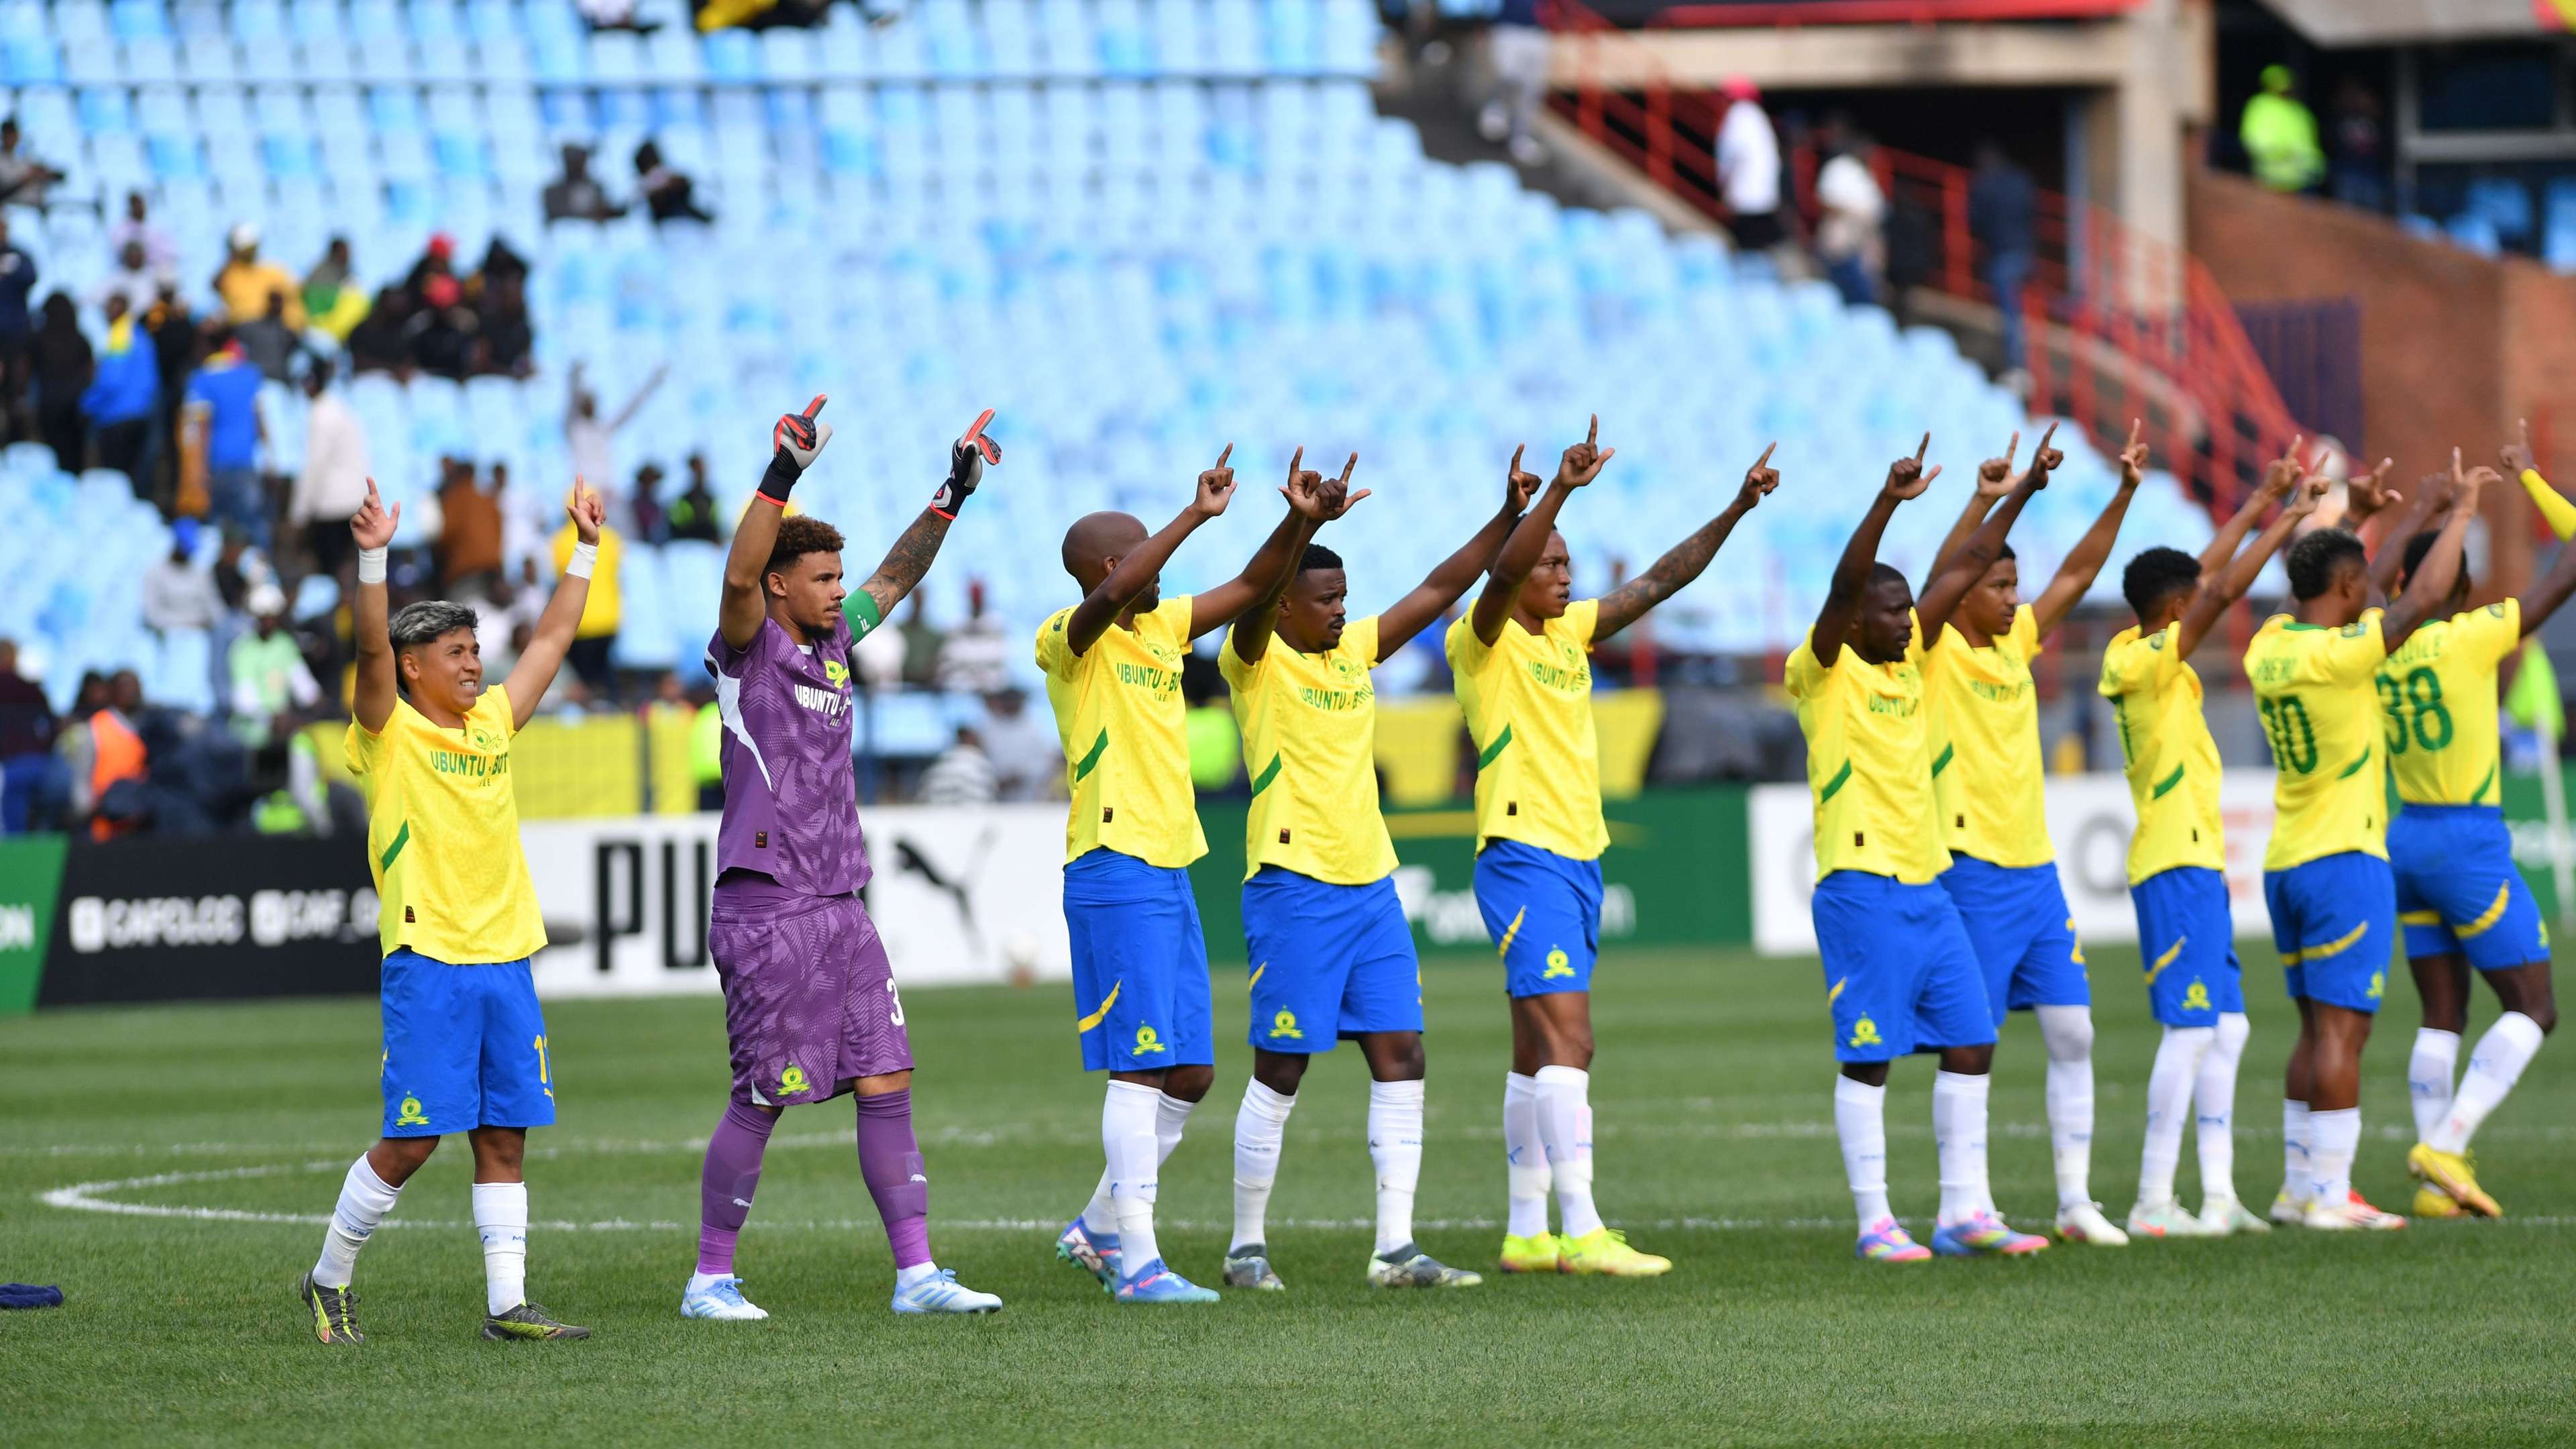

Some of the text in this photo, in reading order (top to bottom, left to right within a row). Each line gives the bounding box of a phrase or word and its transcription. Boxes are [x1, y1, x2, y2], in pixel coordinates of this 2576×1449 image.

[1116, 662, 1163, 690] UBUNTU
[794, 684, 841, 716] UBUNTU
[1299, 686, 1346, 710] UBUNTU
[2375, 666, 2453, 755] 38
[2261, 694, 2318, 774] 10
[430, 750, 487, 777] UBUNTU
[533, 1034, 551, 1085] 1
